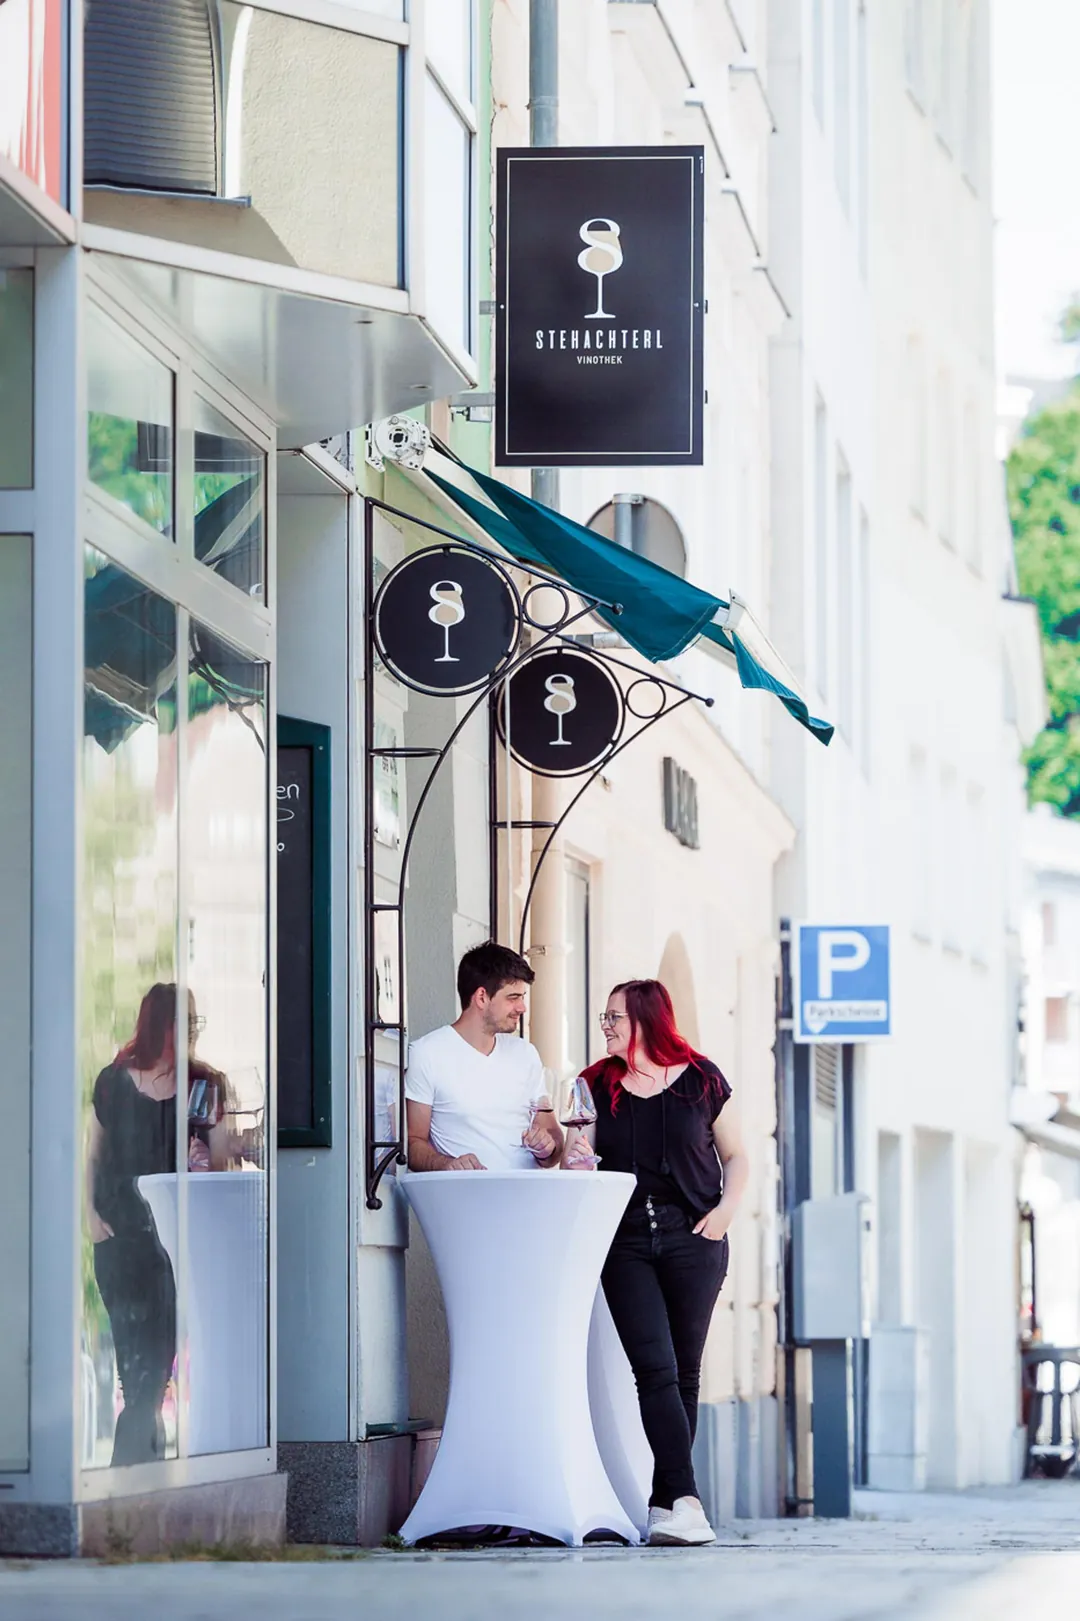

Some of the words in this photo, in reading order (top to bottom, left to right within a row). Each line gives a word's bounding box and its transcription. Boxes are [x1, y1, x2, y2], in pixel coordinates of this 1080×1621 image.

[536, 329, 663, 349] STEHACHTERL
[577, 355, 623, 365] VINOTHEK
[818, 931, 871, 999] P
